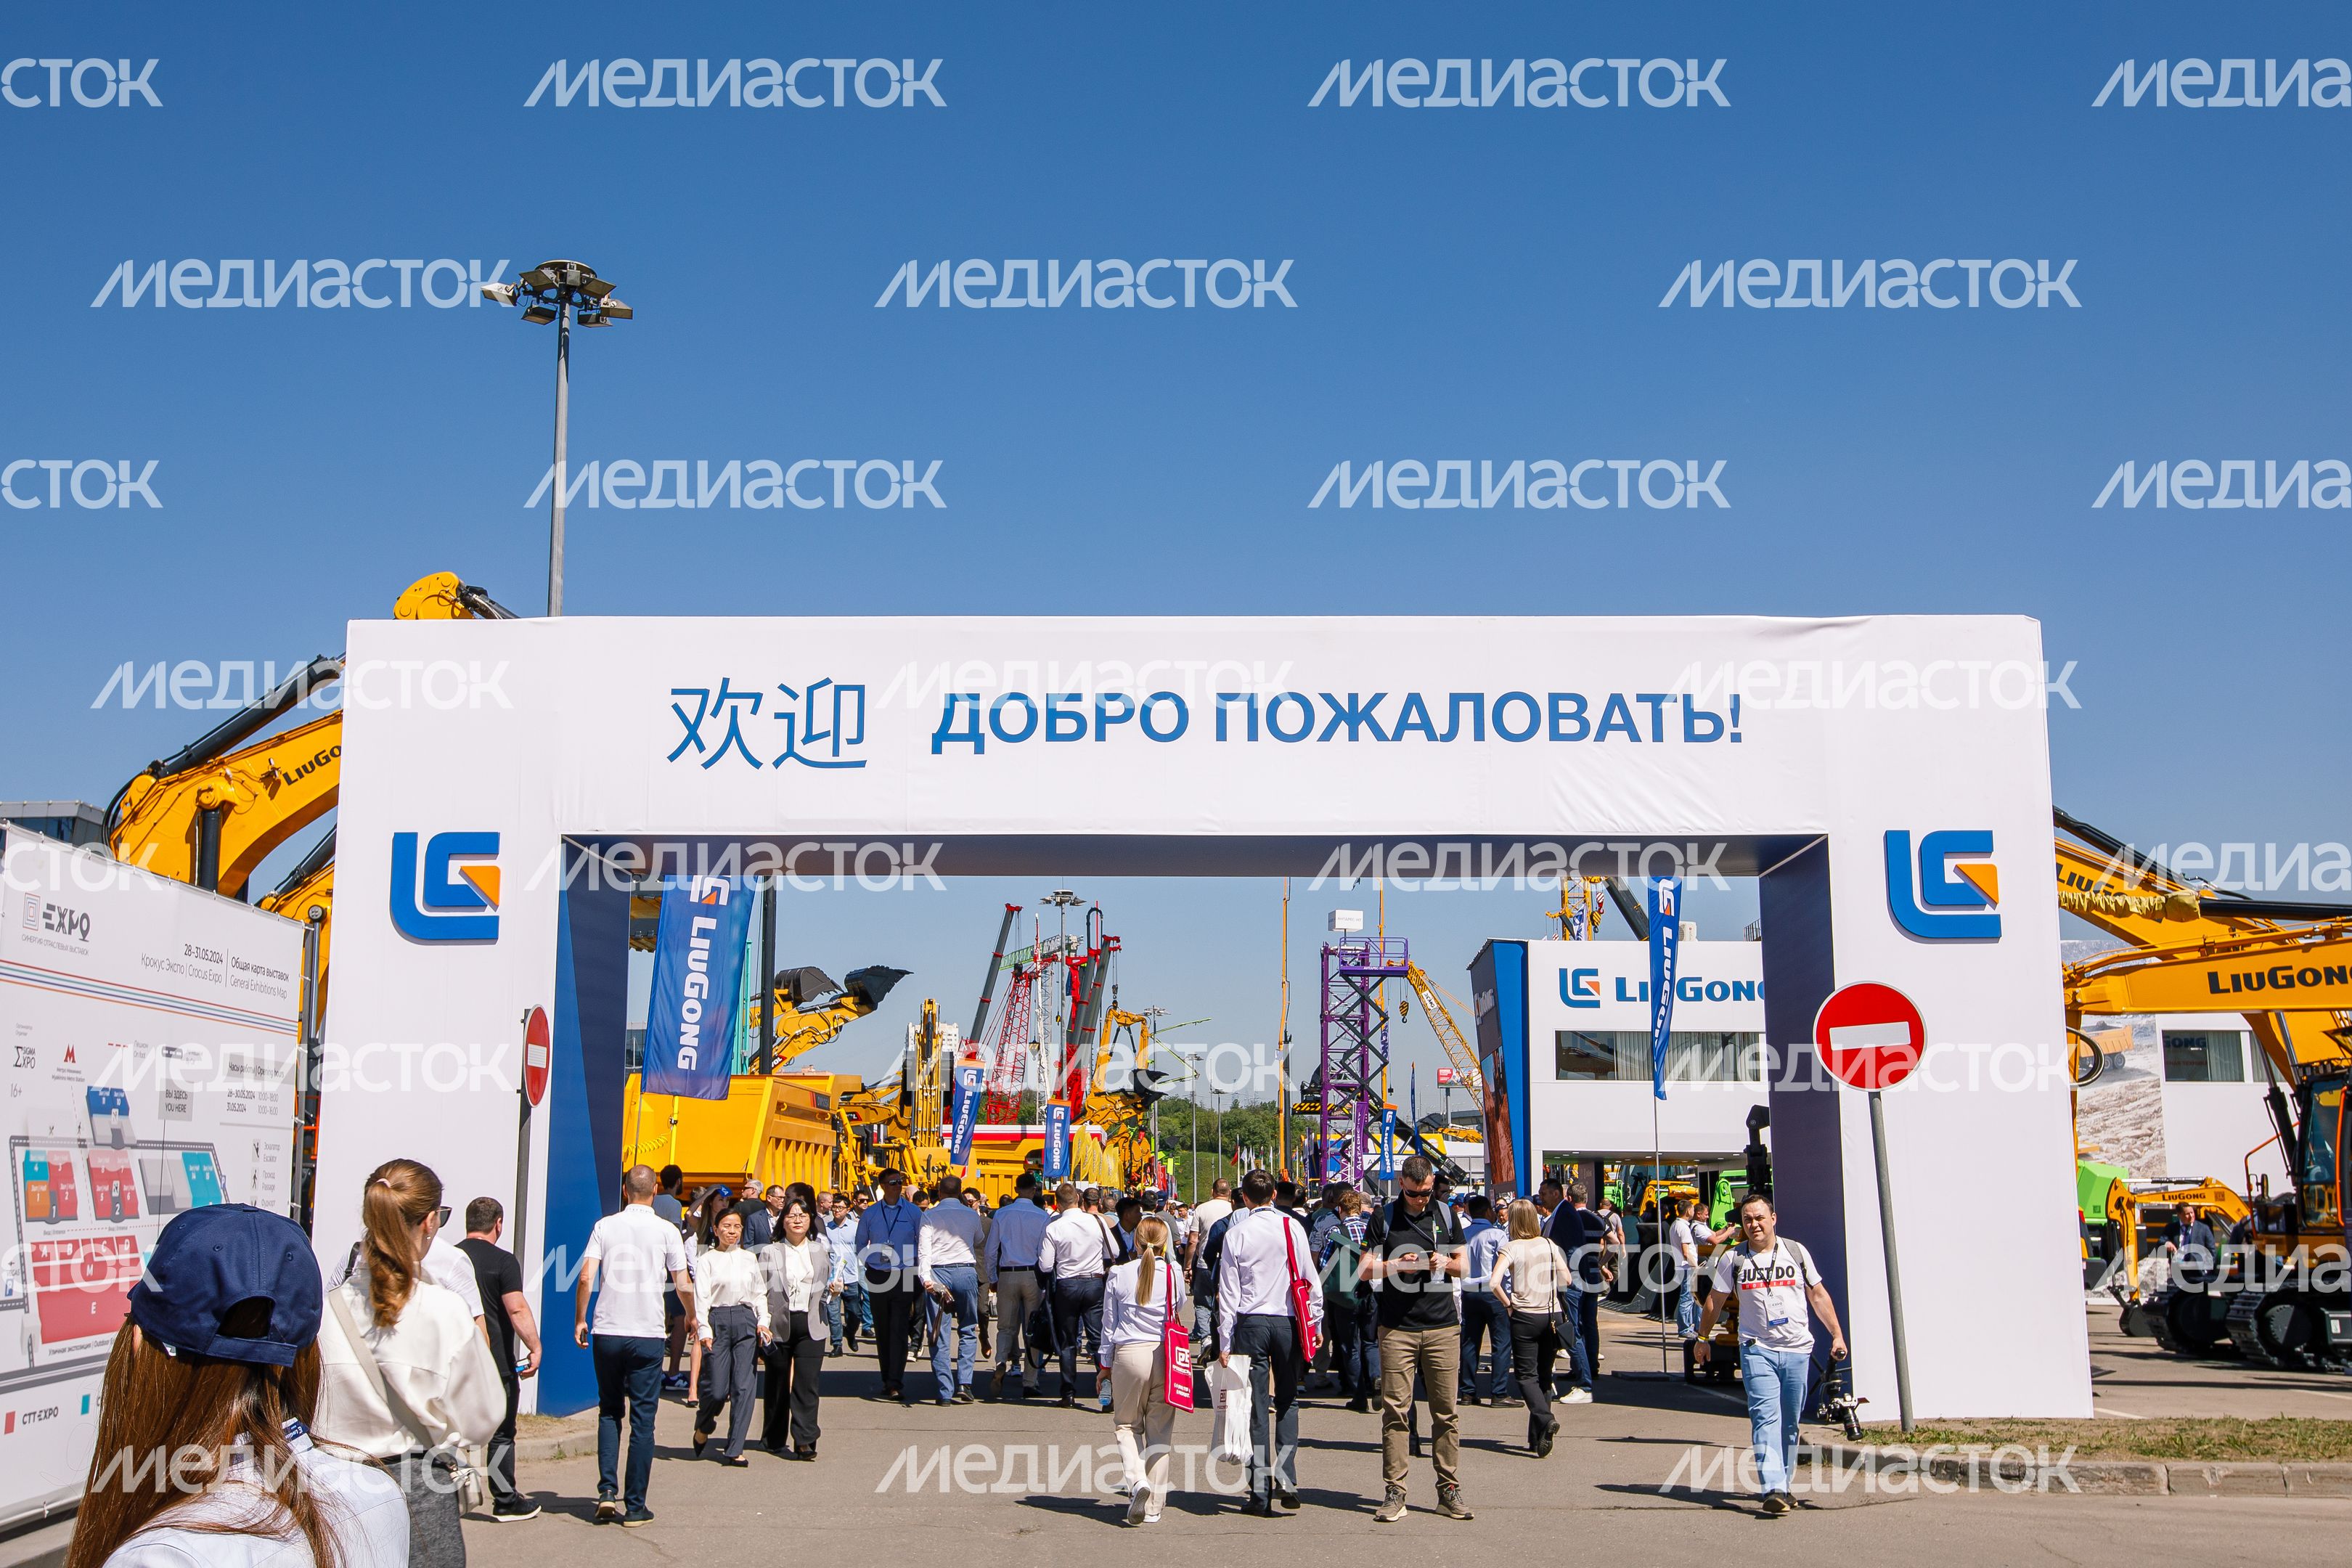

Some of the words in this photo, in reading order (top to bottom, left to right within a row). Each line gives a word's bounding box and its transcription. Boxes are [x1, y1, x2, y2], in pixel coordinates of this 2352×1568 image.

[666, 677, 868, 771] 欢迎
[931, 691, 1190, 755] ДОБРО
[1215, 691, 1742, 743] ПОЖАЛОВАТЬ!
[141, 952, 165, 973] Крокус
[166, 958, 185, 975] Экспо
[208, 969, 222, 986] Expo
[231, 956, 250, 973] Общая
[266, 968, 290, 983] выставок
[2207, 965, 2352, 995] LIUGON
[677, 915, 717, 1071] LIUGONG
[166, 1103, 174, 1112] YOU
[175, 1104, 187, 1114] HERE
[1741, 1267, 1773, 1283] JUST
[1776, 1265, 1795, 1280] DO
